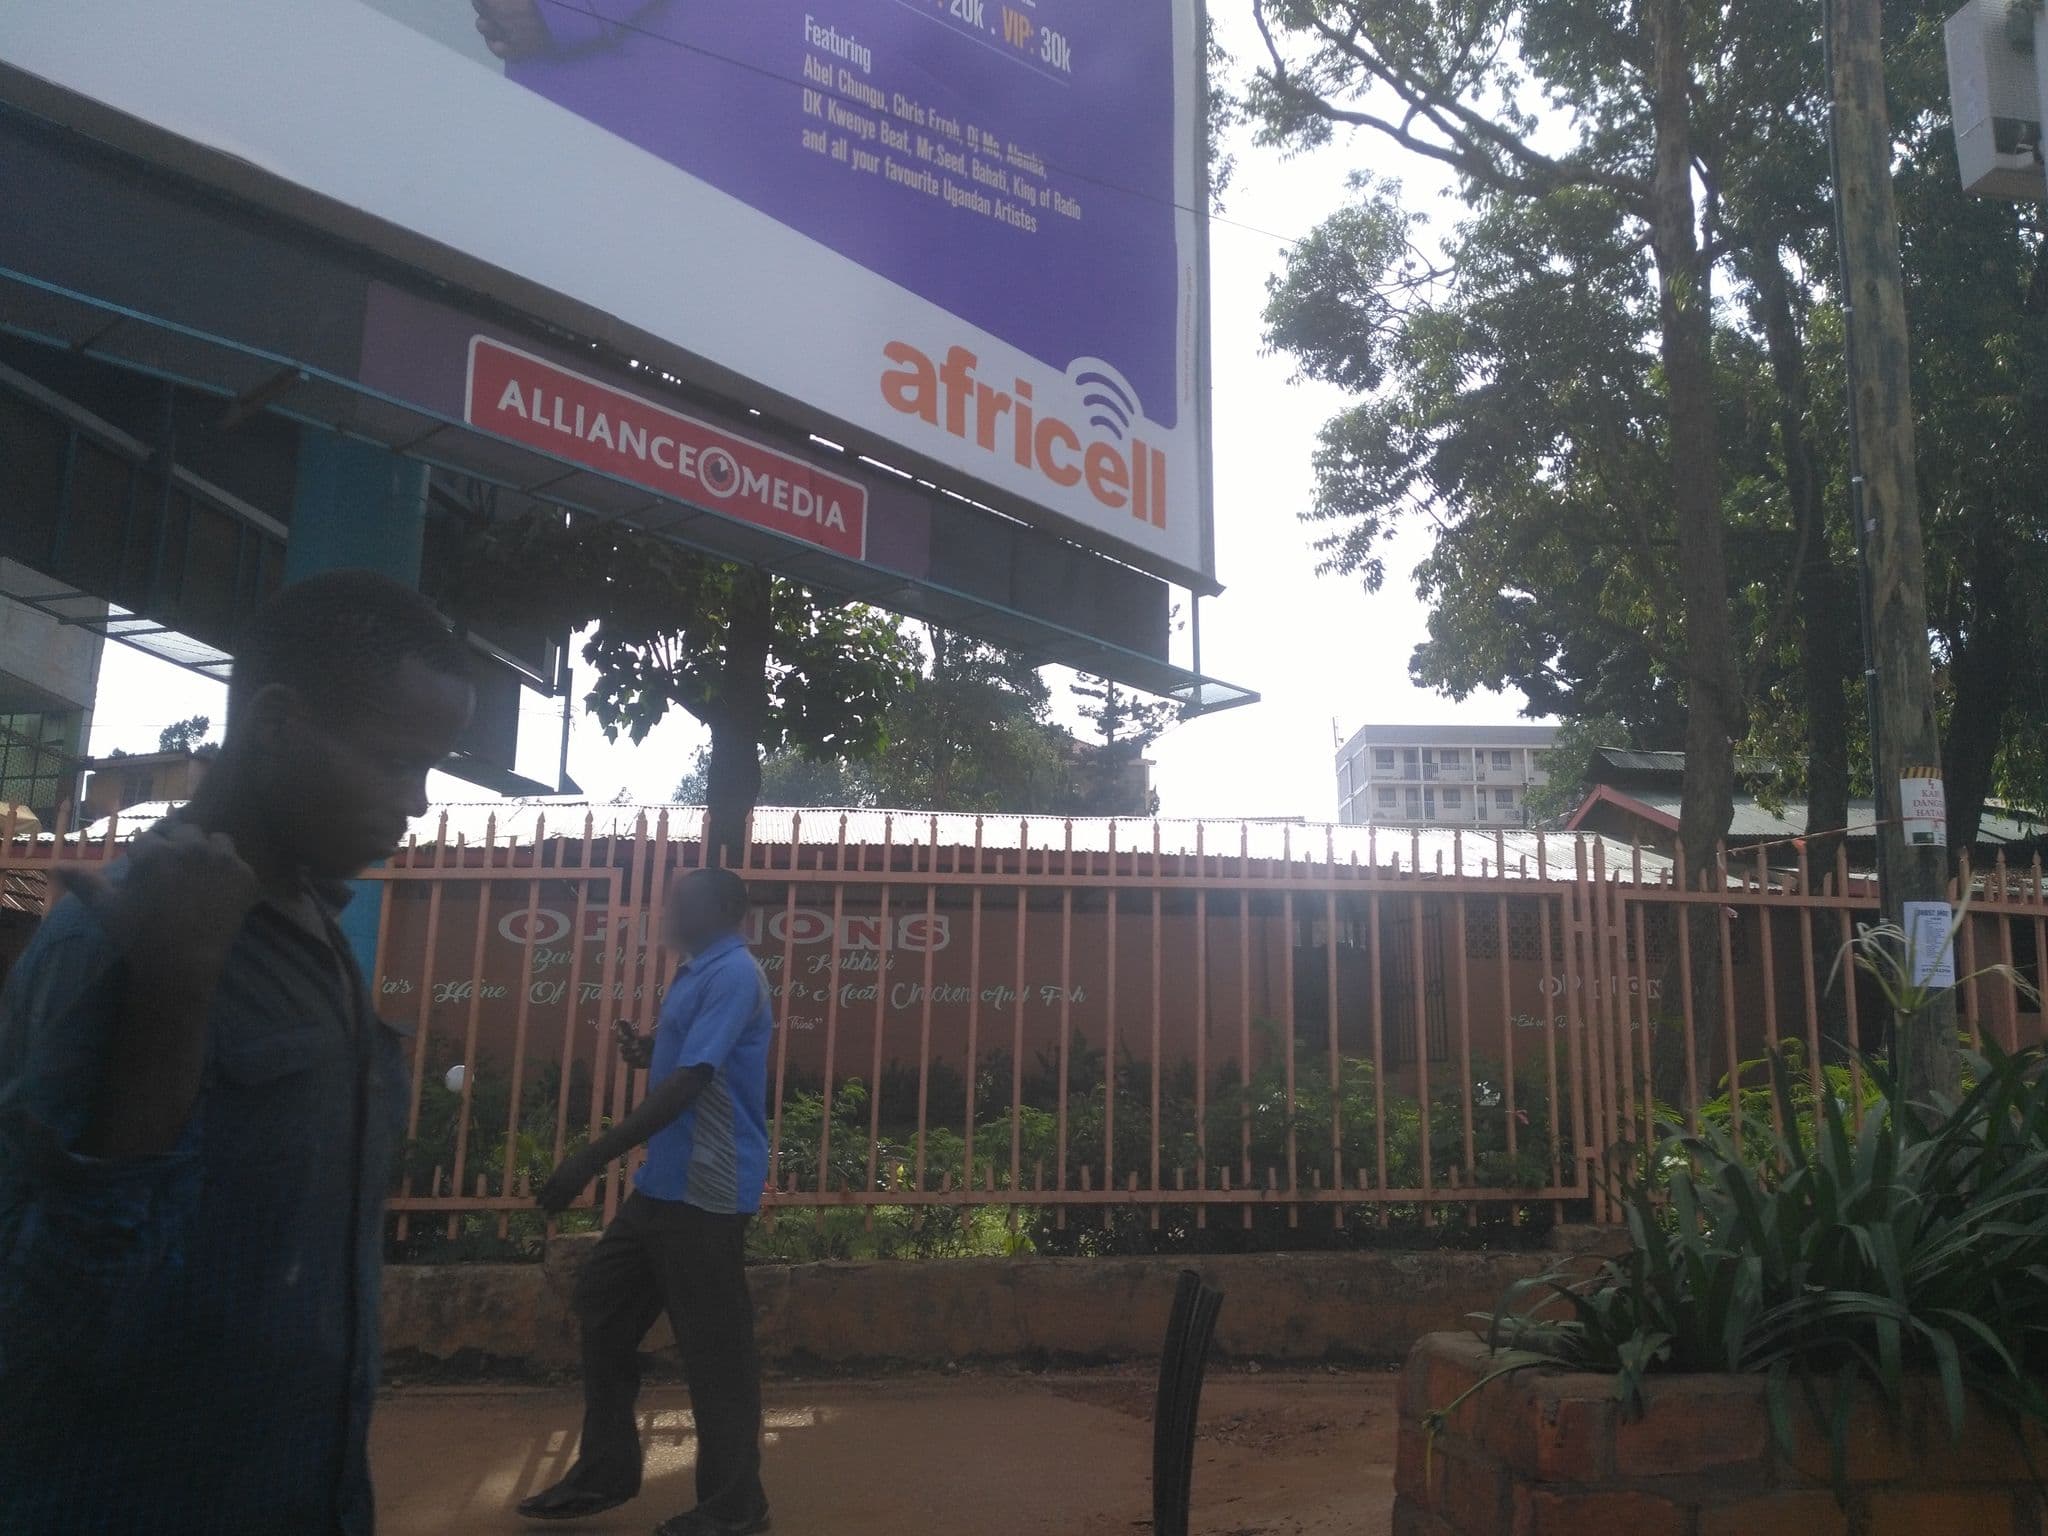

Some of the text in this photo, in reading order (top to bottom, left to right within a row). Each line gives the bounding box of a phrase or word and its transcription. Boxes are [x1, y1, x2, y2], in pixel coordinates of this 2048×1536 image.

[803, 53, 833, 87] Abel
[893, 93, 925, 125] Chris
[804, 13, 870, 74] Featuring
[1040, 26, 1071, 73] 30k
[802, 128, 1037, 233] and all your favourite Ugandan Artistes
[803, 88, 822, 117] DK
[828, 97, 875, 140] Kwenye
[1013, 175, 1036, 207] King
[1040, 189, 1051, 209] of
[1054, 191, 1081, 221] Radio
[497, 378, 847, 534] ALLIANCE MEDIA
[880, 340, 1166, 530] africell
